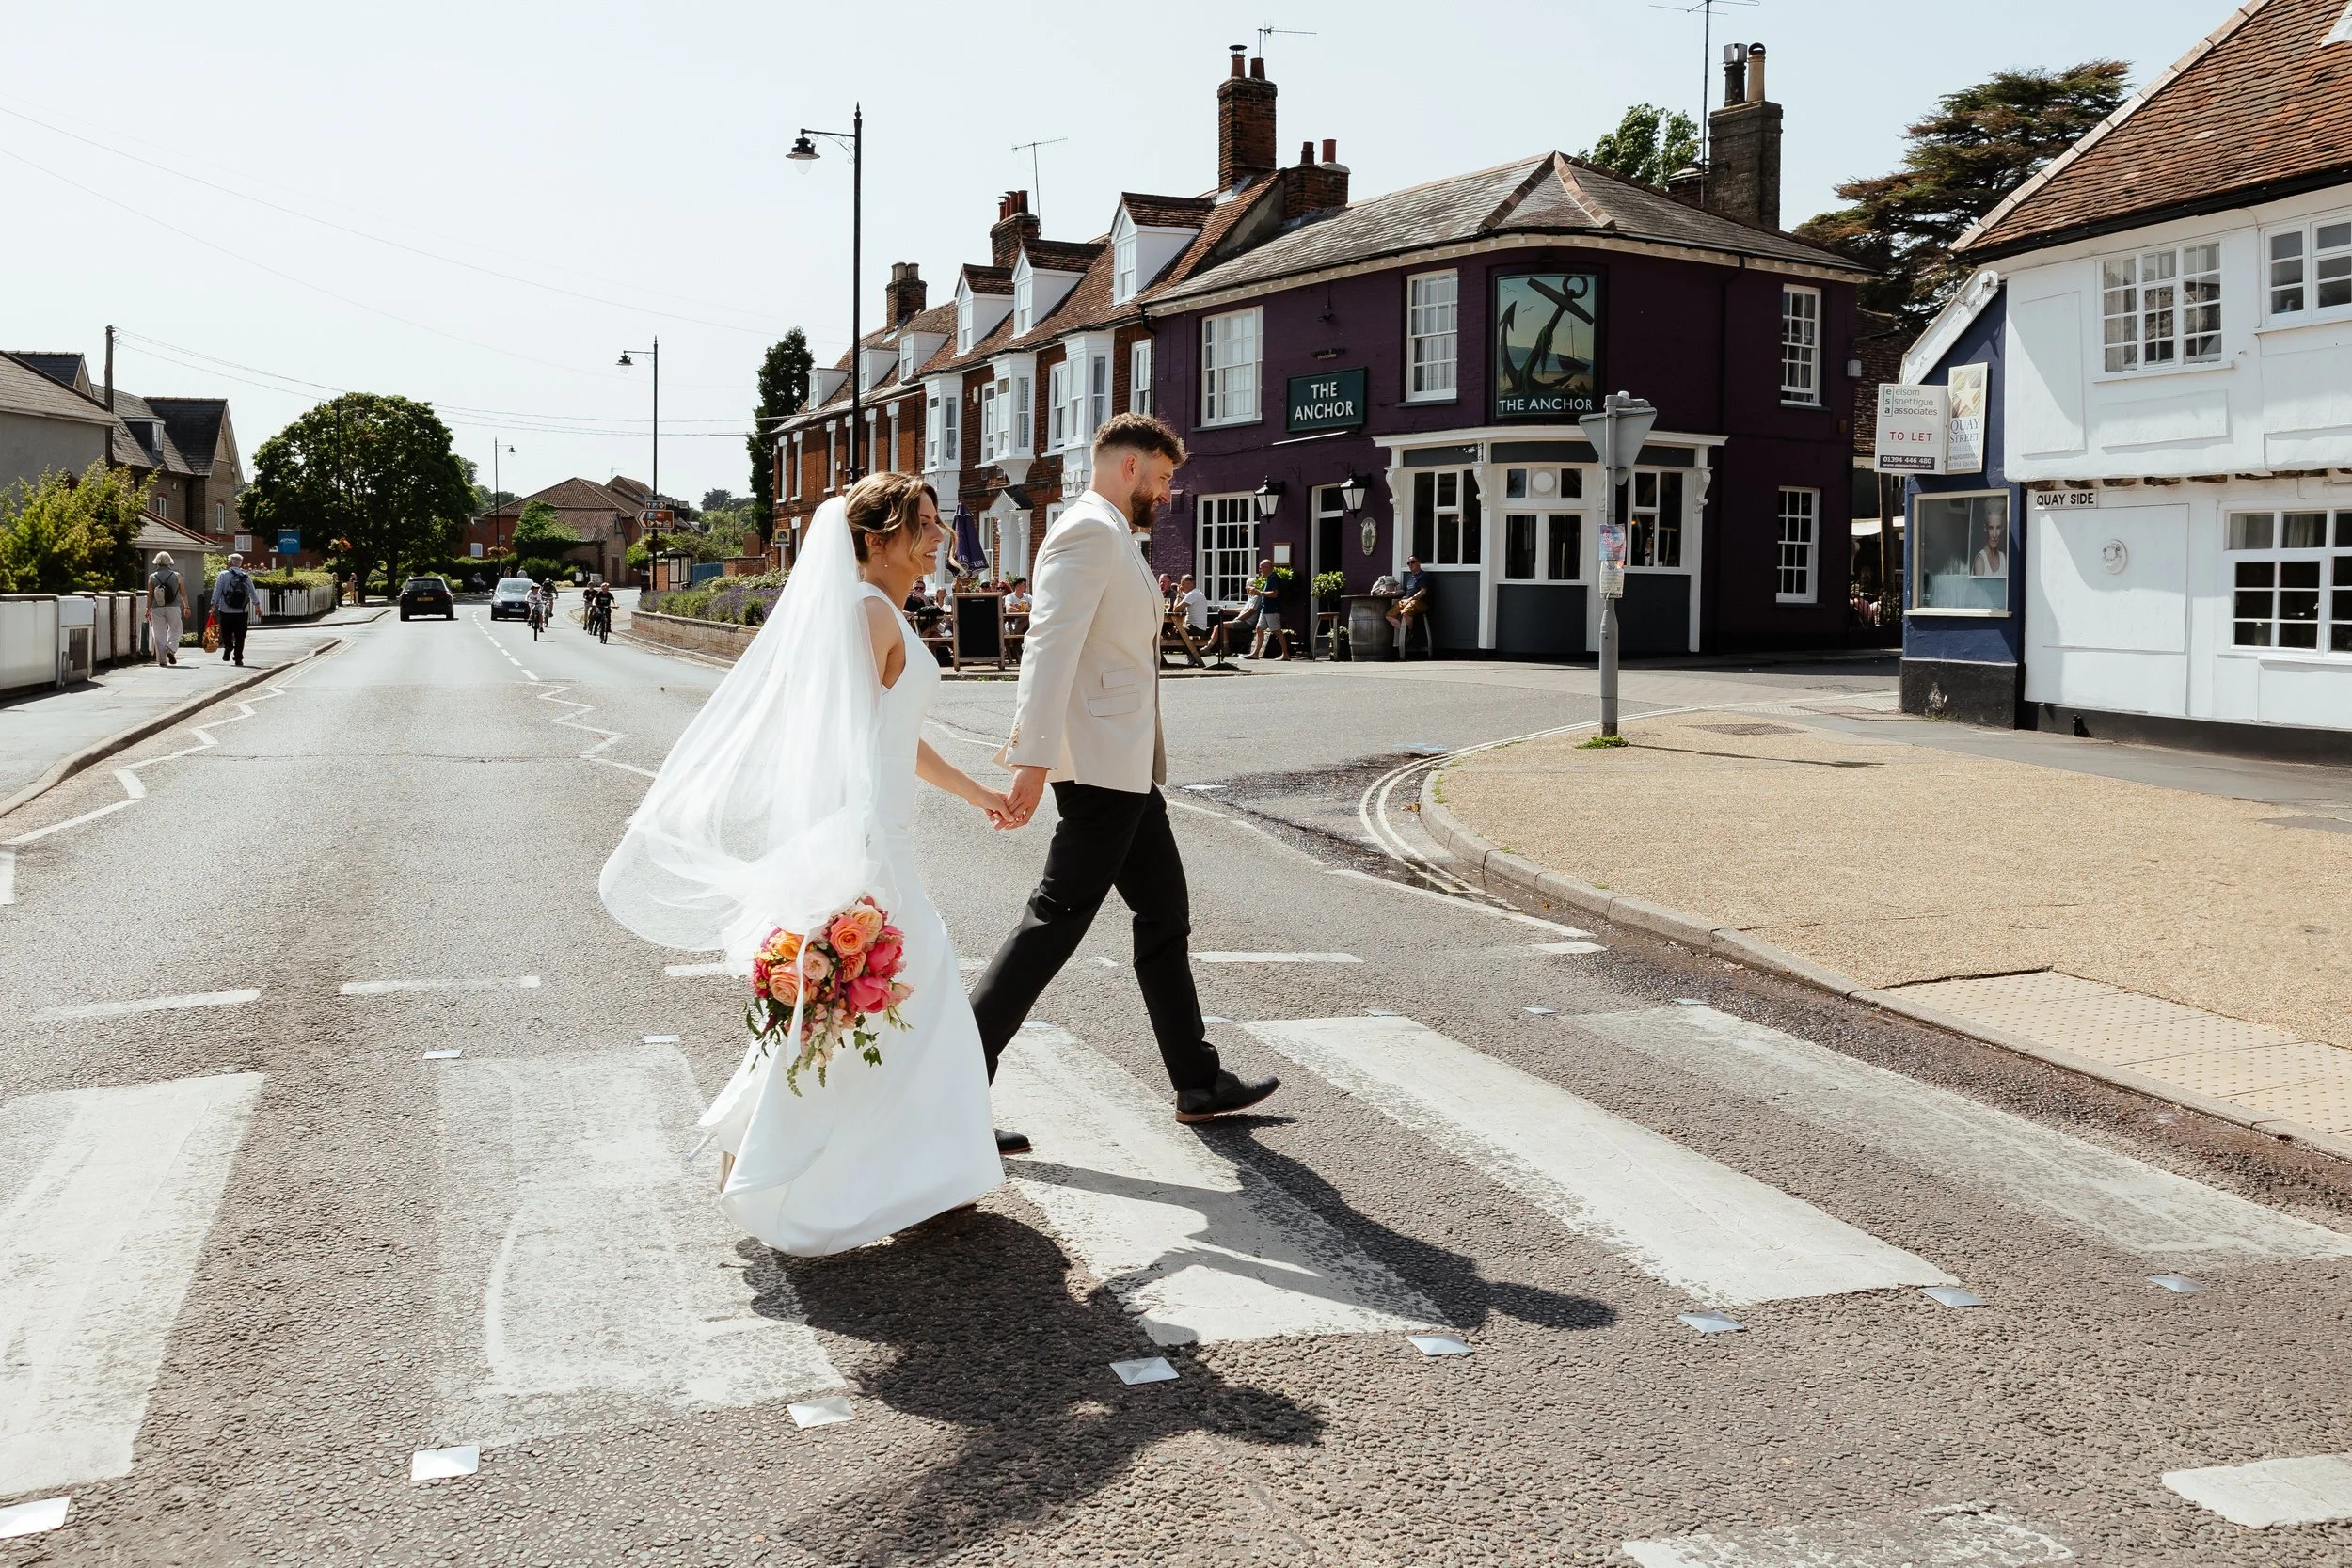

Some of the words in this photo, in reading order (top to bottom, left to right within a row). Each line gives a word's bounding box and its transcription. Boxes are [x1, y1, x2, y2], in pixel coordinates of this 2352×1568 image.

[1311, 381, 1338, 399] THE
[1895, 388, 1920, 396] elsom
[1499, 399, 1524, 412] THE
[1528, 398, 1593, 411] ANCHOR
[1894, 398, 1934, 407] spettigue
[1294, 401, 1354, 421] ANCHOR
[1950, 418, 1980, 434] QUAY
[1889, 431, 1905, 441] TO
[1911, 432, 1933, 441] LET
[1949, 433, 1980, 443] STREET
[2036, 494, 2066, 506] QUAY
[2070, 492, 2094, 505] SIDE
